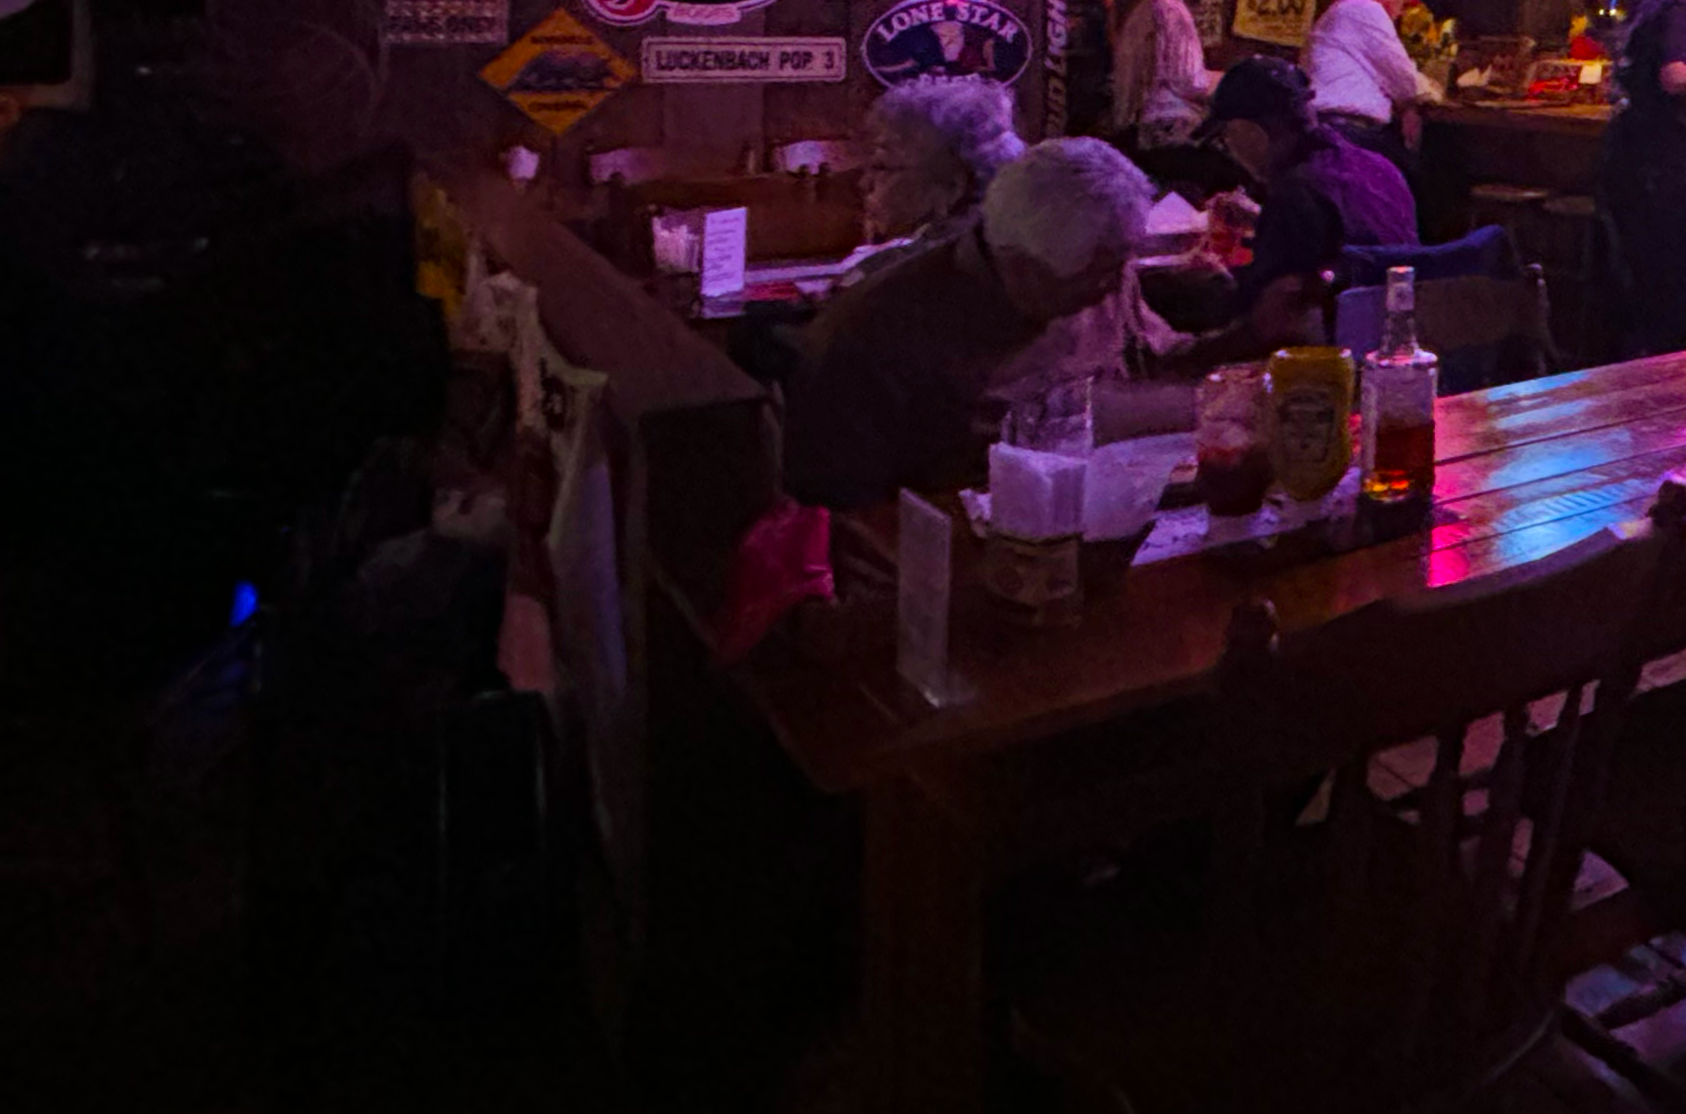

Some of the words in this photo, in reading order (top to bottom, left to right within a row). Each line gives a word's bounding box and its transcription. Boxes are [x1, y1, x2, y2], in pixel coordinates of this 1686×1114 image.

[877, 1, 945, 42] LONE
[955, 2, 1020, 43] STAR
[656, 49, 769, 70] LUCKENBACH
[780, 51, 812, 70] POP
[825, 51, 834, 70] 3
